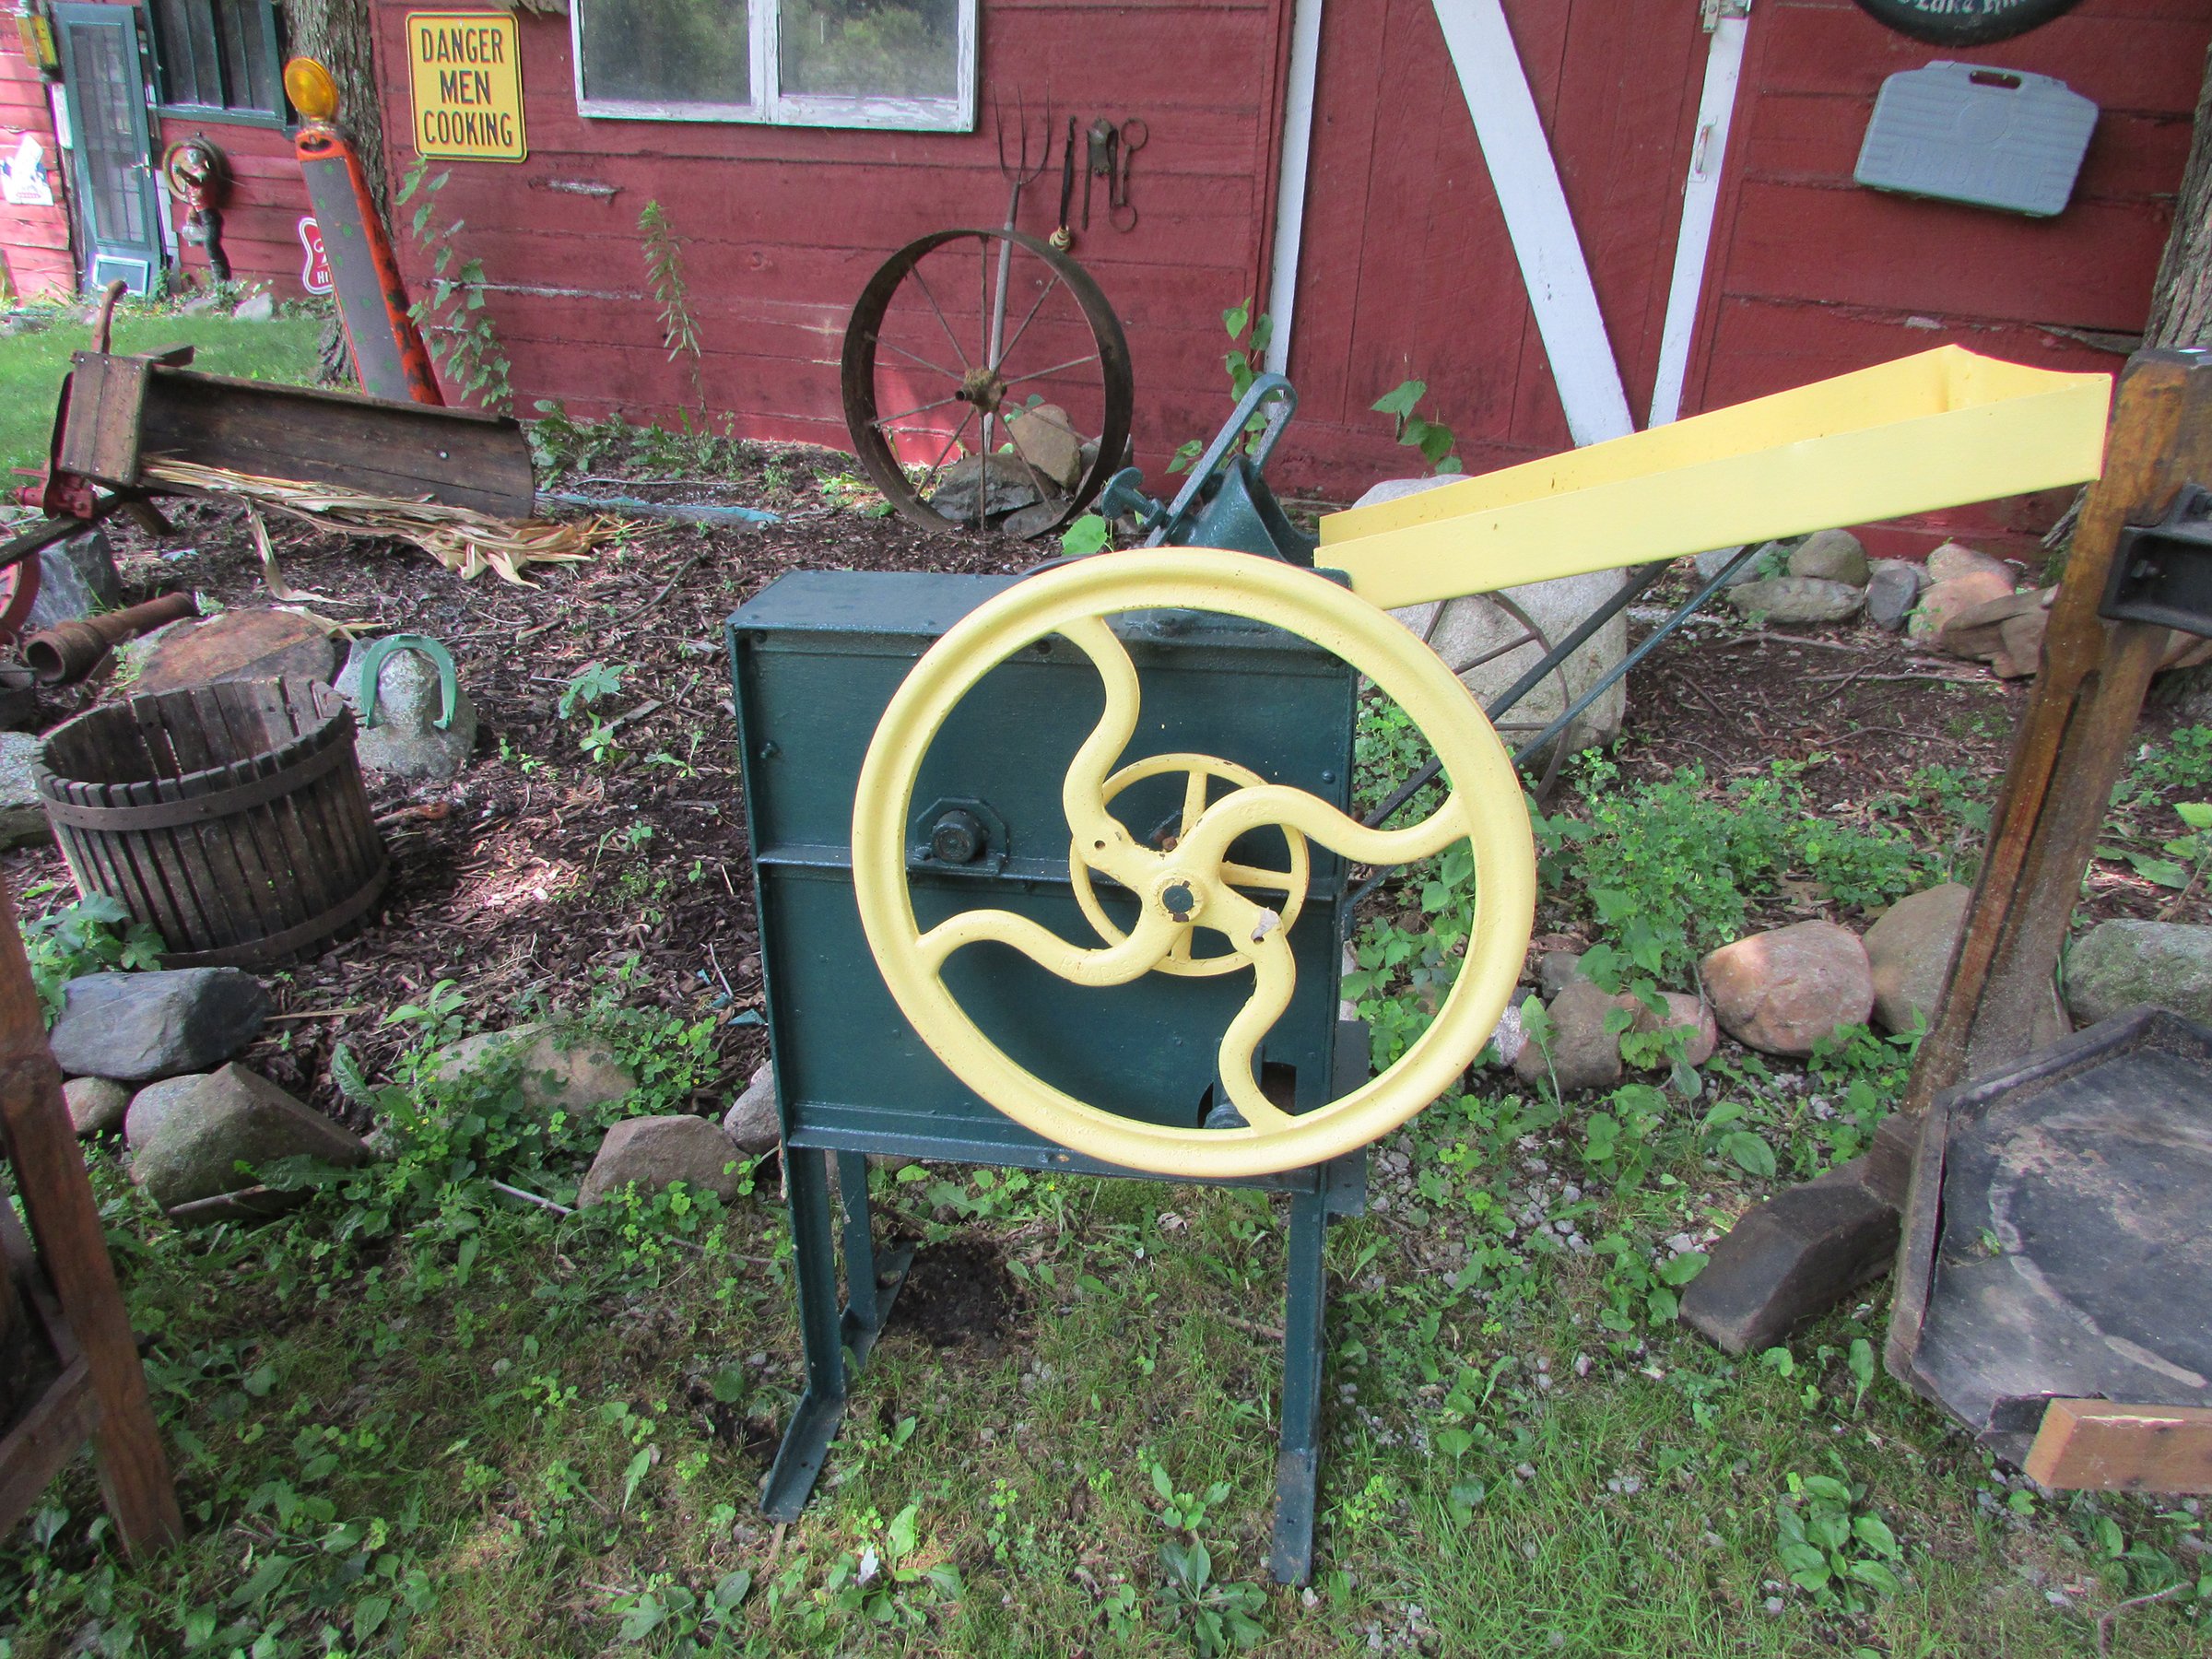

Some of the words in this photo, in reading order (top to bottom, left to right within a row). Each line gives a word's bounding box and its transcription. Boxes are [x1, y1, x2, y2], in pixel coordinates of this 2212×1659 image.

[421, 28, 504, 64] DANGER
[440, 70, 491, 105] MEN
[424, 110, 513, 147] COOKING
